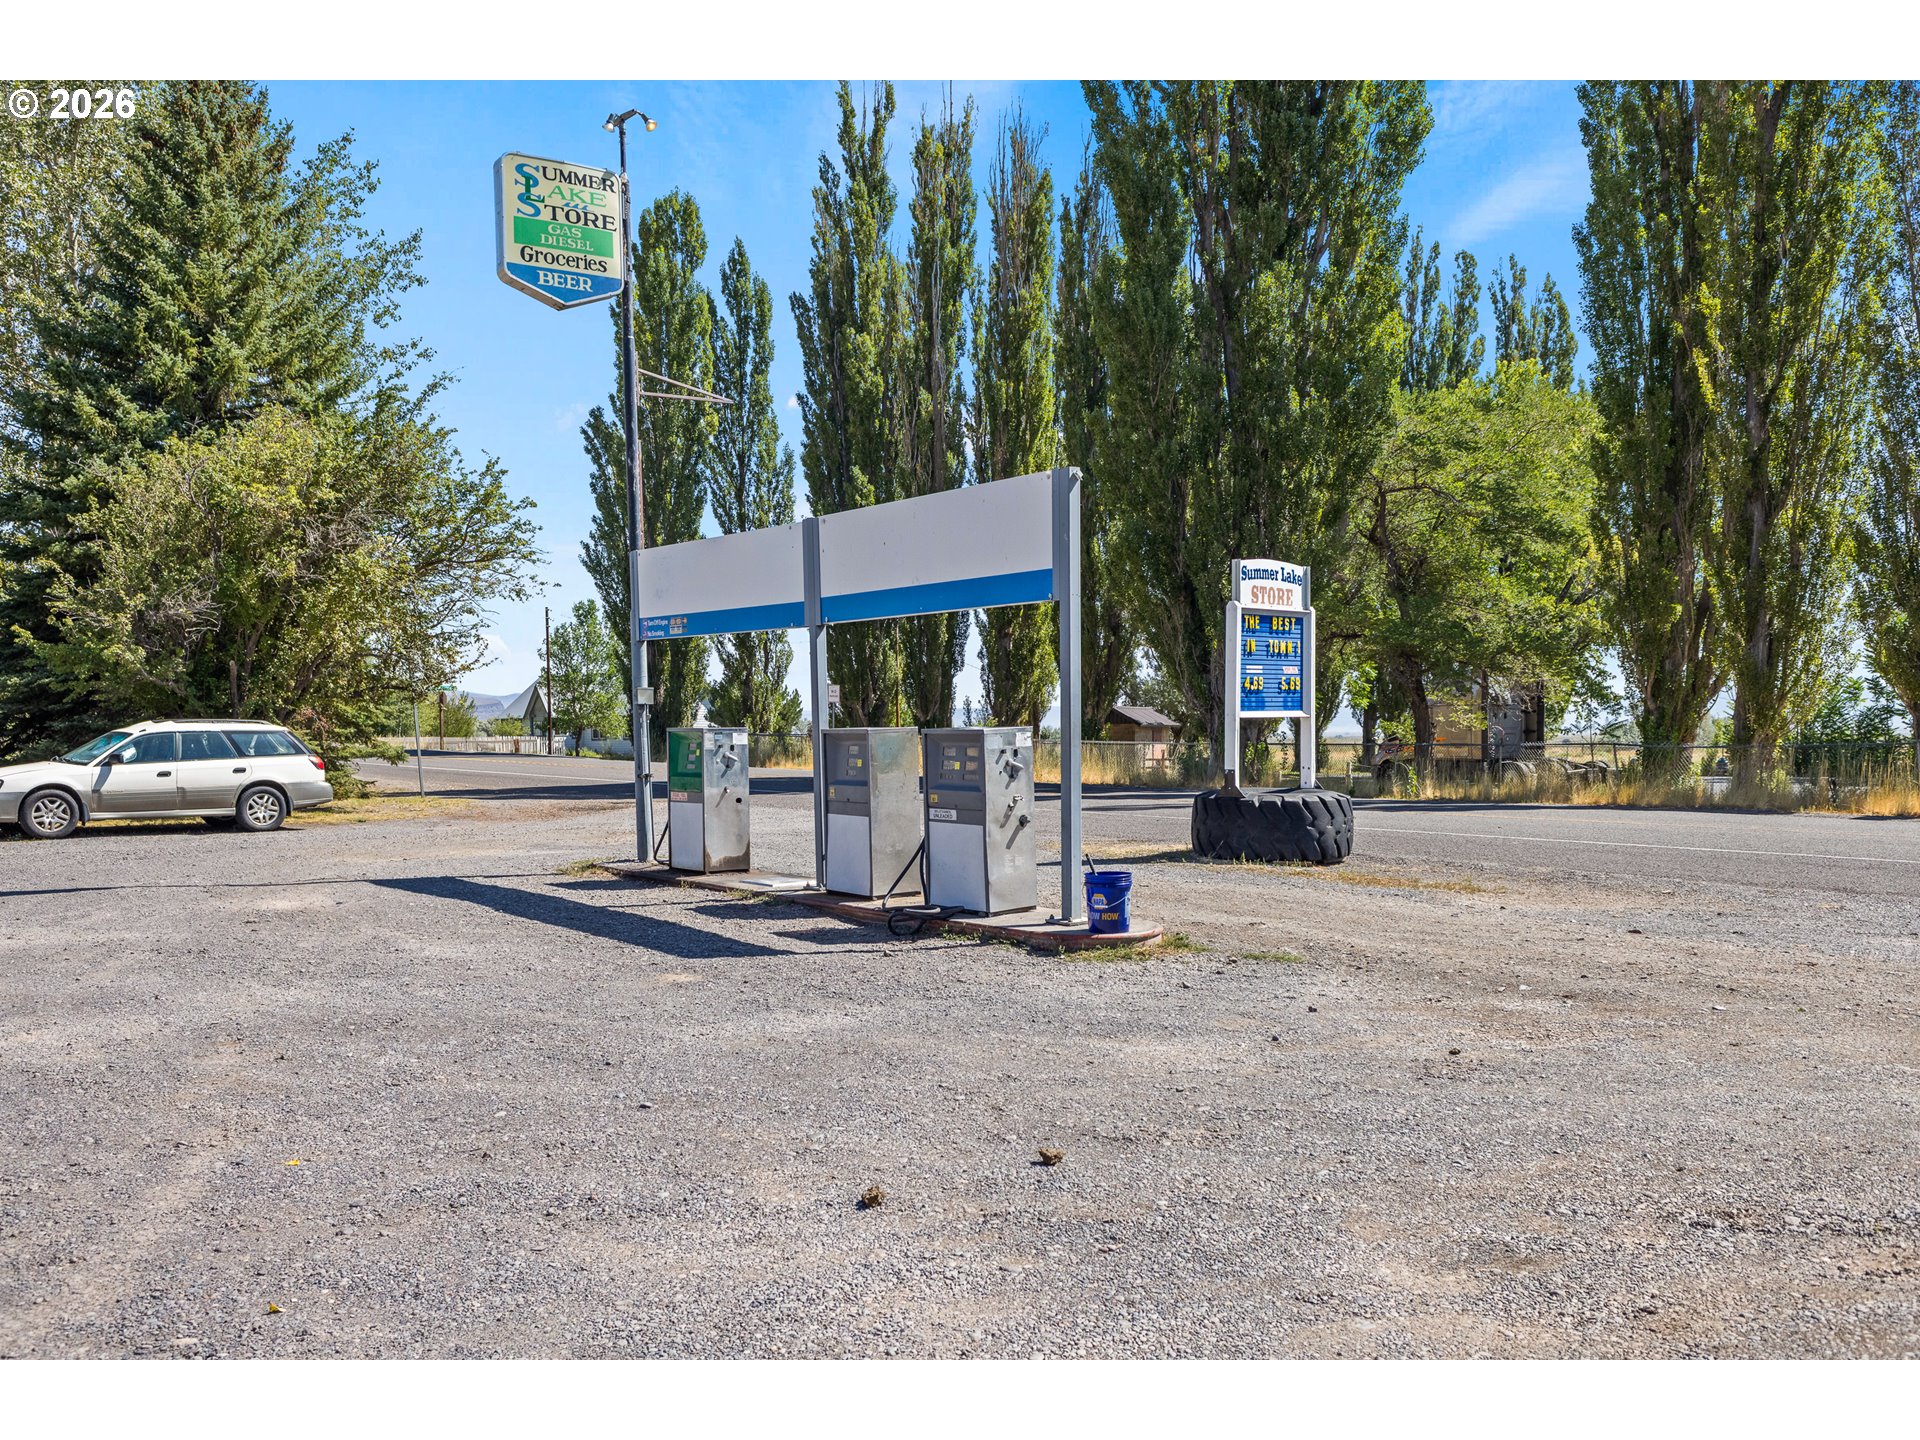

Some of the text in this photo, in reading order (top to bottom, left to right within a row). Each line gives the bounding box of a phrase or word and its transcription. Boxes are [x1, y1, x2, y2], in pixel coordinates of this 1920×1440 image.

[514, 163, 617, 194] SUMMER
[522, 175, 607, 208] LAKE
[516, 191, 617, 232] STORE
[540, 233, 594, 251] DIESEL
[547, 224, 582, 239] GAS
[520, 245, 608, 273] Groceries
[536, 270, 593, 292] BEER
[1241, 565, 1303, 586] Summer Lake
[1251, 585, 1293, 606] STORE
[1244, 615, 1296, 631] THE BEST
[1247, 638, 1256, 652] IN
[1244, 676, 1264, 690] 4.69
[1088, 912, 1119, 920] OW HOW
